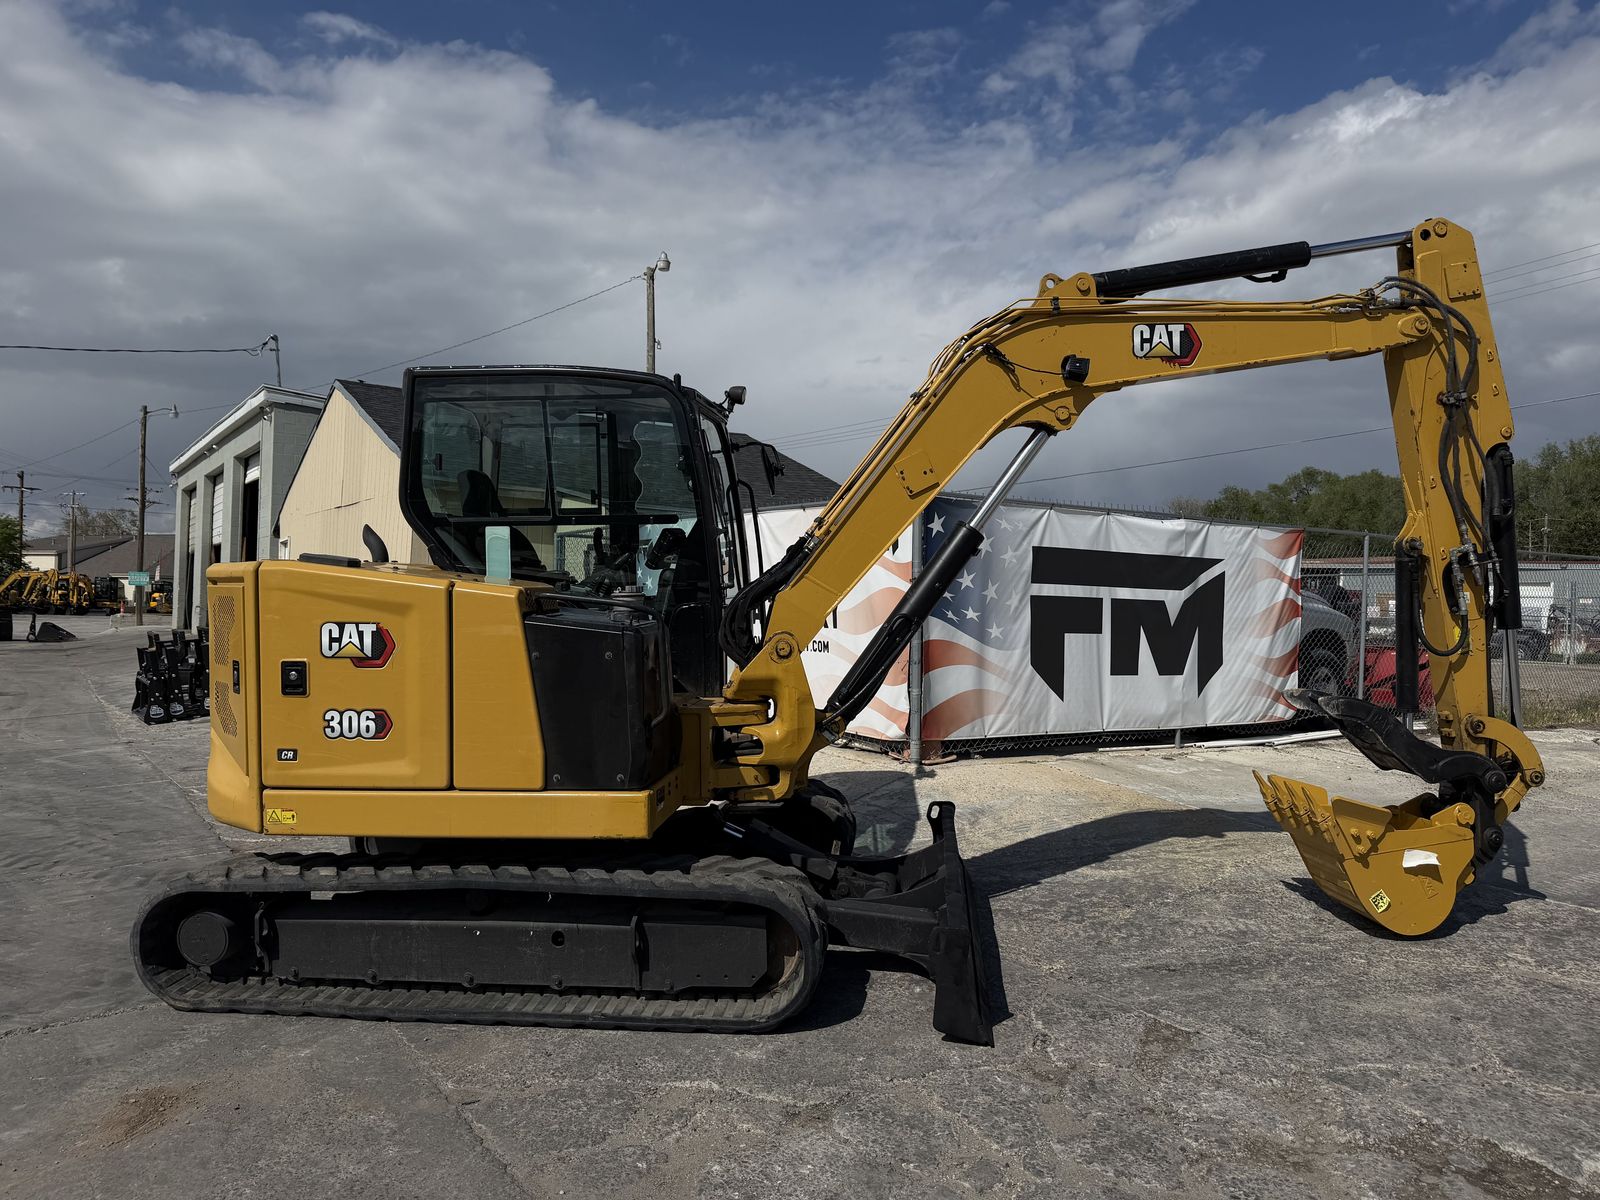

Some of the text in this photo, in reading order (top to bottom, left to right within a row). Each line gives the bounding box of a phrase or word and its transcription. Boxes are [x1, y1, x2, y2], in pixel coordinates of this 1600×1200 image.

[1133, 324, 1184, 357] CAT
[321, 622, 376, 657] CAT
[1030, 546, 1225, 702] FM
[324, 710, 376, 738] 306
[281, 750, 294, 760] CR
